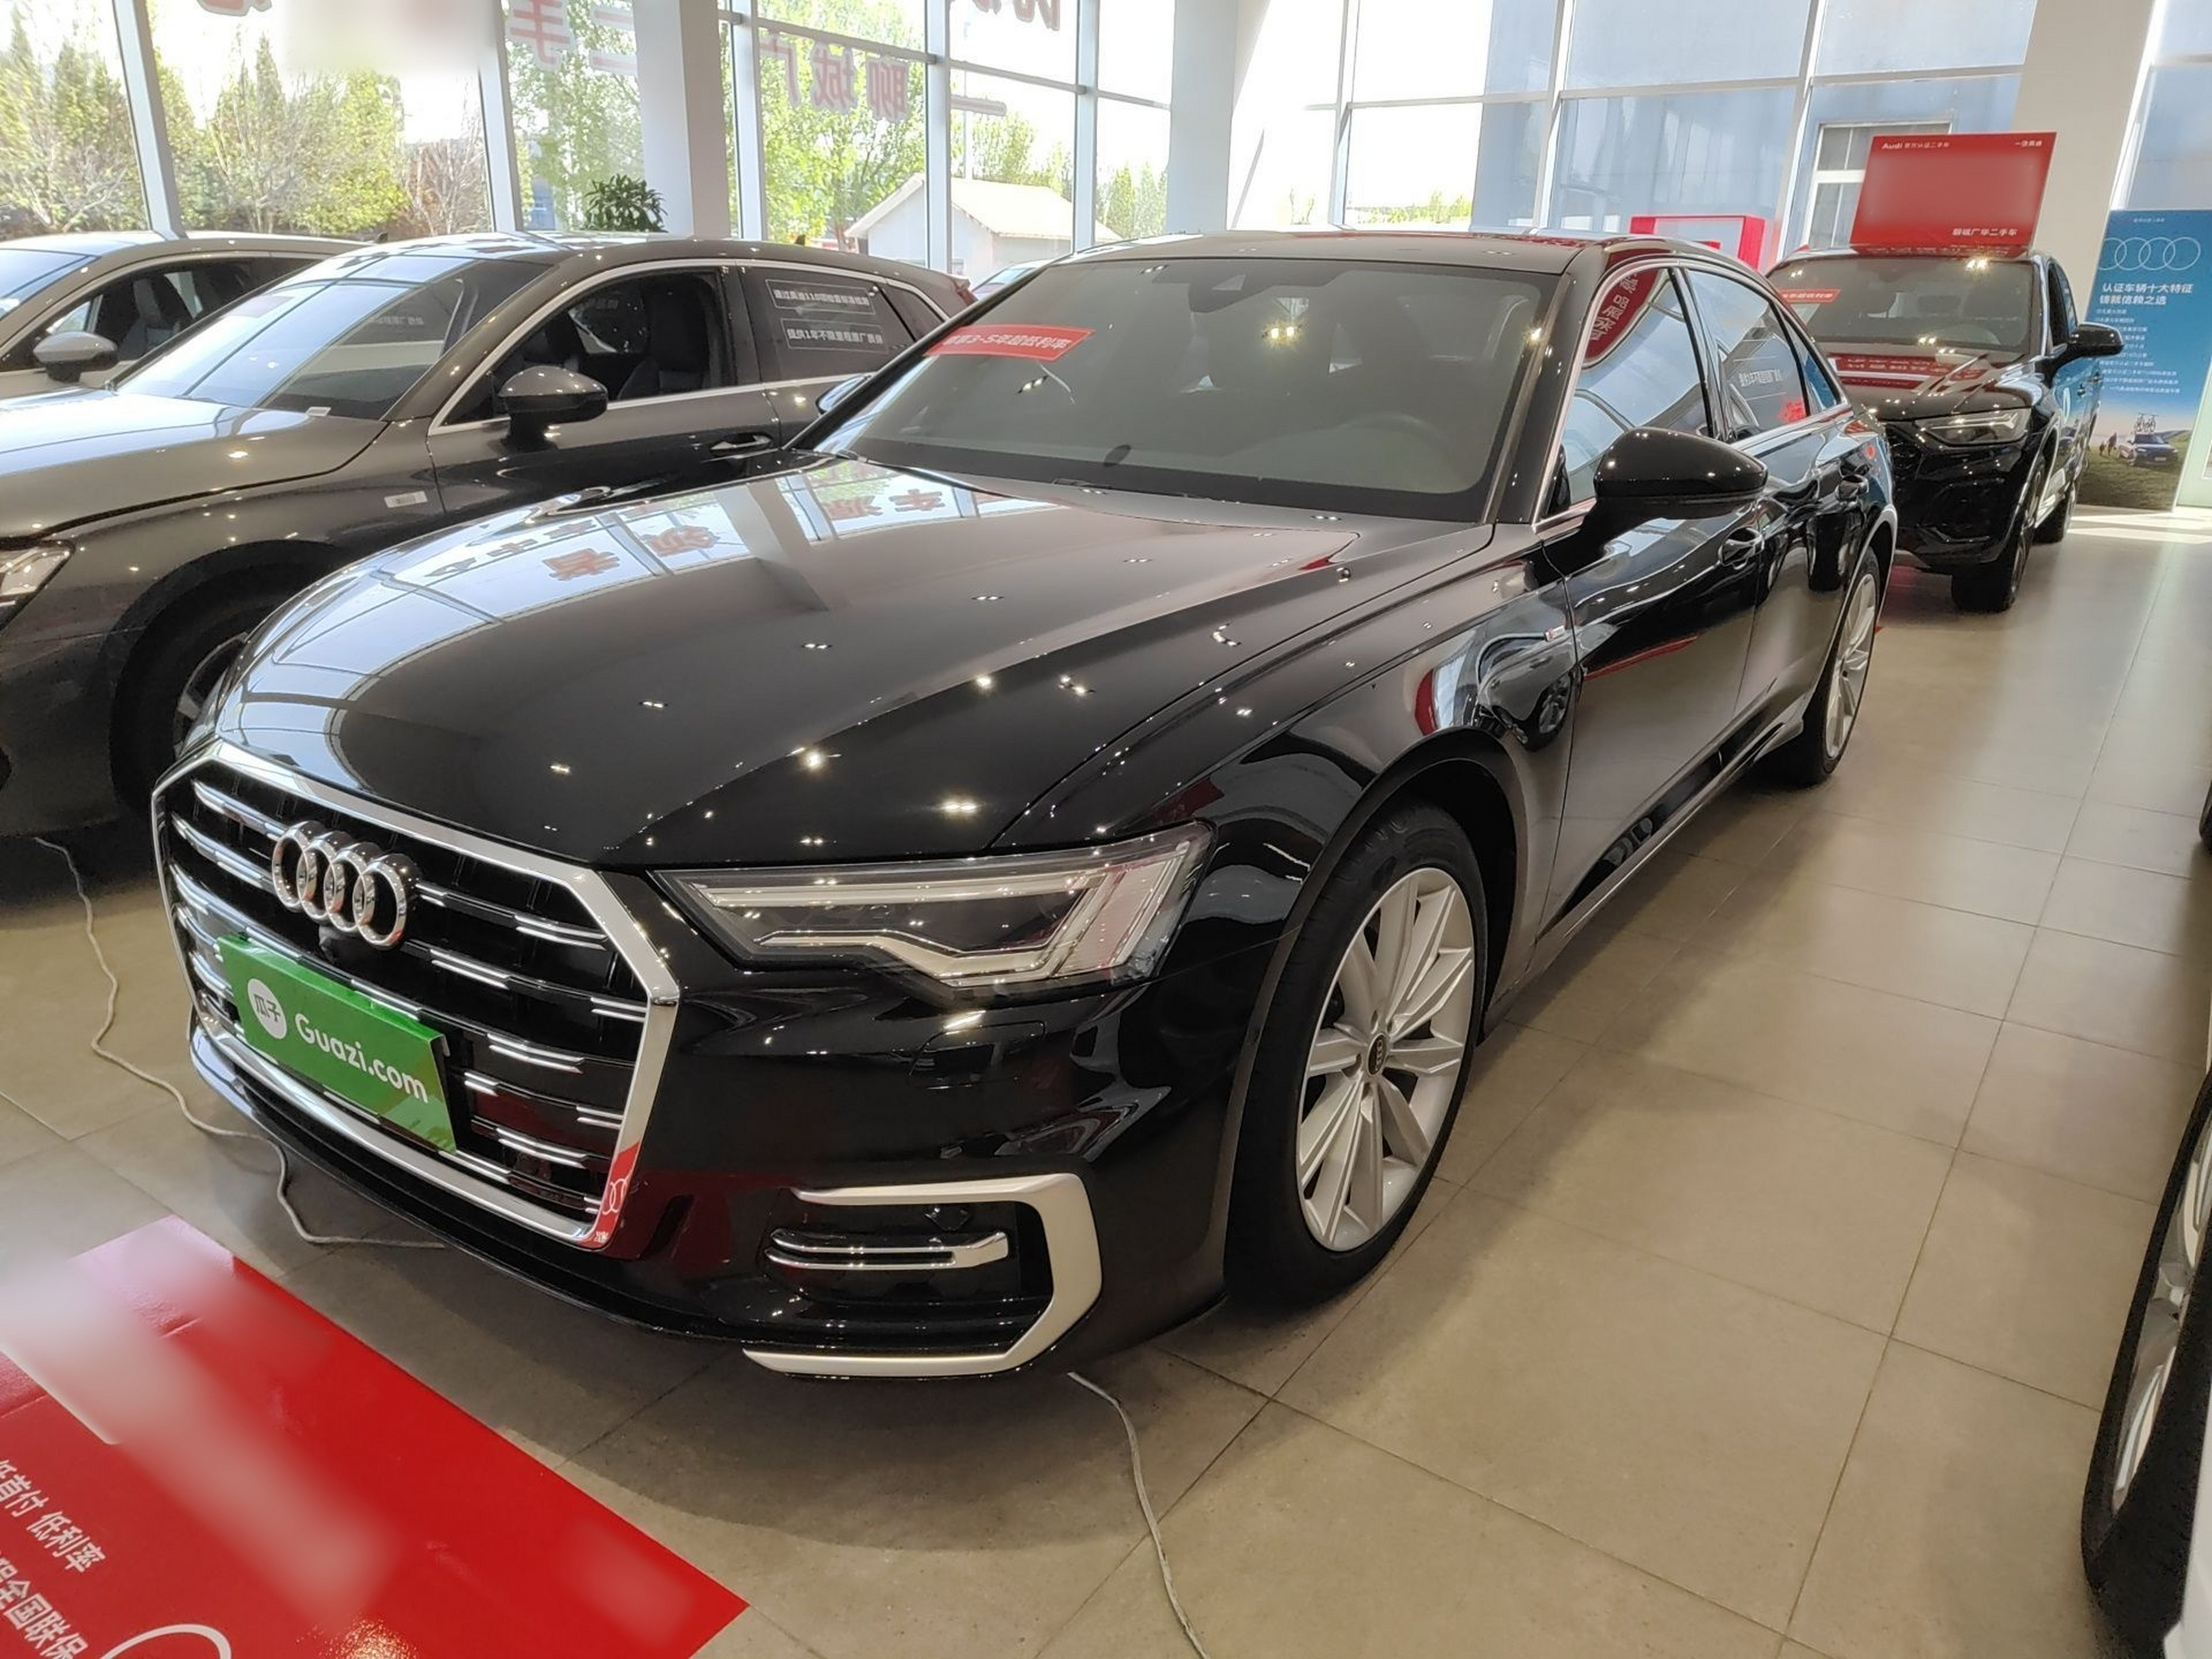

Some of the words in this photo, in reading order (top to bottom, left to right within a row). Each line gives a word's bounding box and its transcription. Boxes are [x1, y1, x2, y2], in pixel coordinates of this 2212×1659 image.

[2103, 283, 2194, 294] 认证车辆十大特征
[253, 994, 282, 1023] 瓜子
[294, 1013, 428, 1104] Guazi.com
[25, 1510, 107, 1573] 低利率
